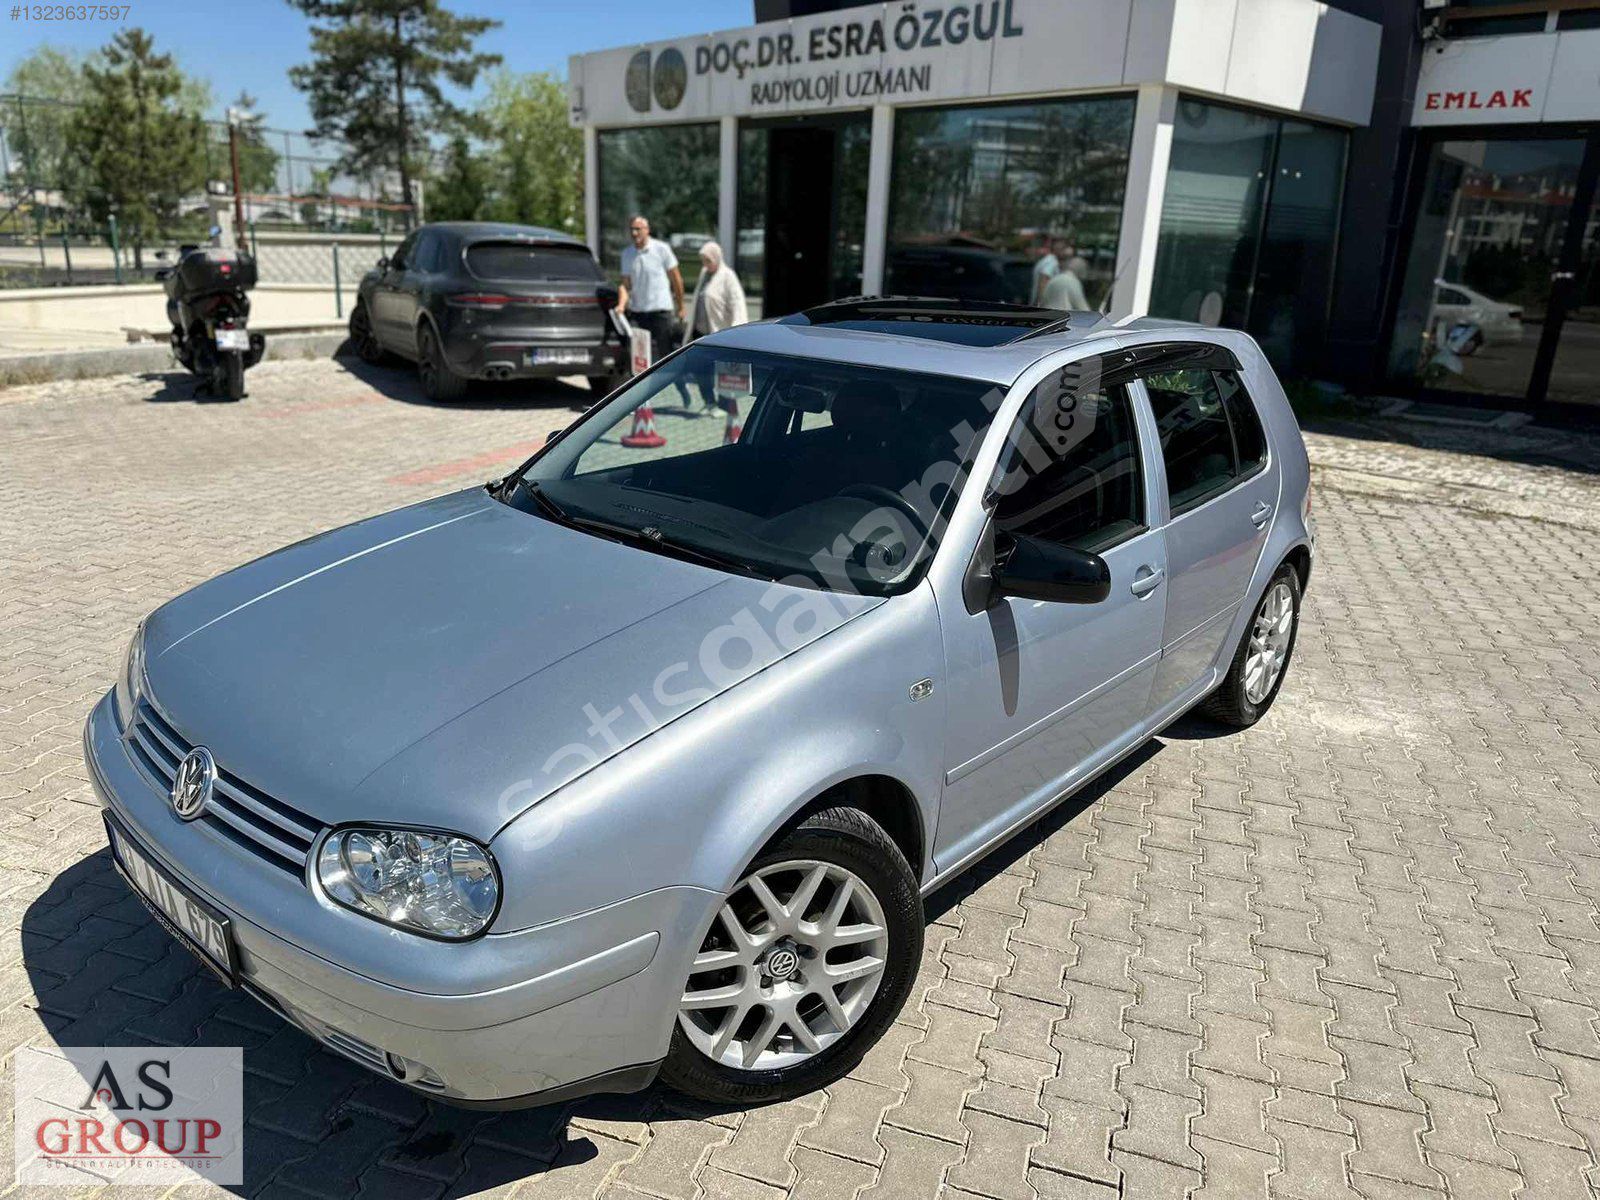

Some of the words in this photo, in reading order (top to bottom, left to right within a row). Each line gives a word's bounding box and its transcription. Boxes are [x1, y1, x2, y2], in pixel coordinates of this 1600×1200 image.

[694, 33, 801, 79] DOÇ.DR.
[808, 19, 887, 62] ESRA
[845, 64, 932, 98] UZMANI
[1425, 89, 1533, 110] EMLAK
